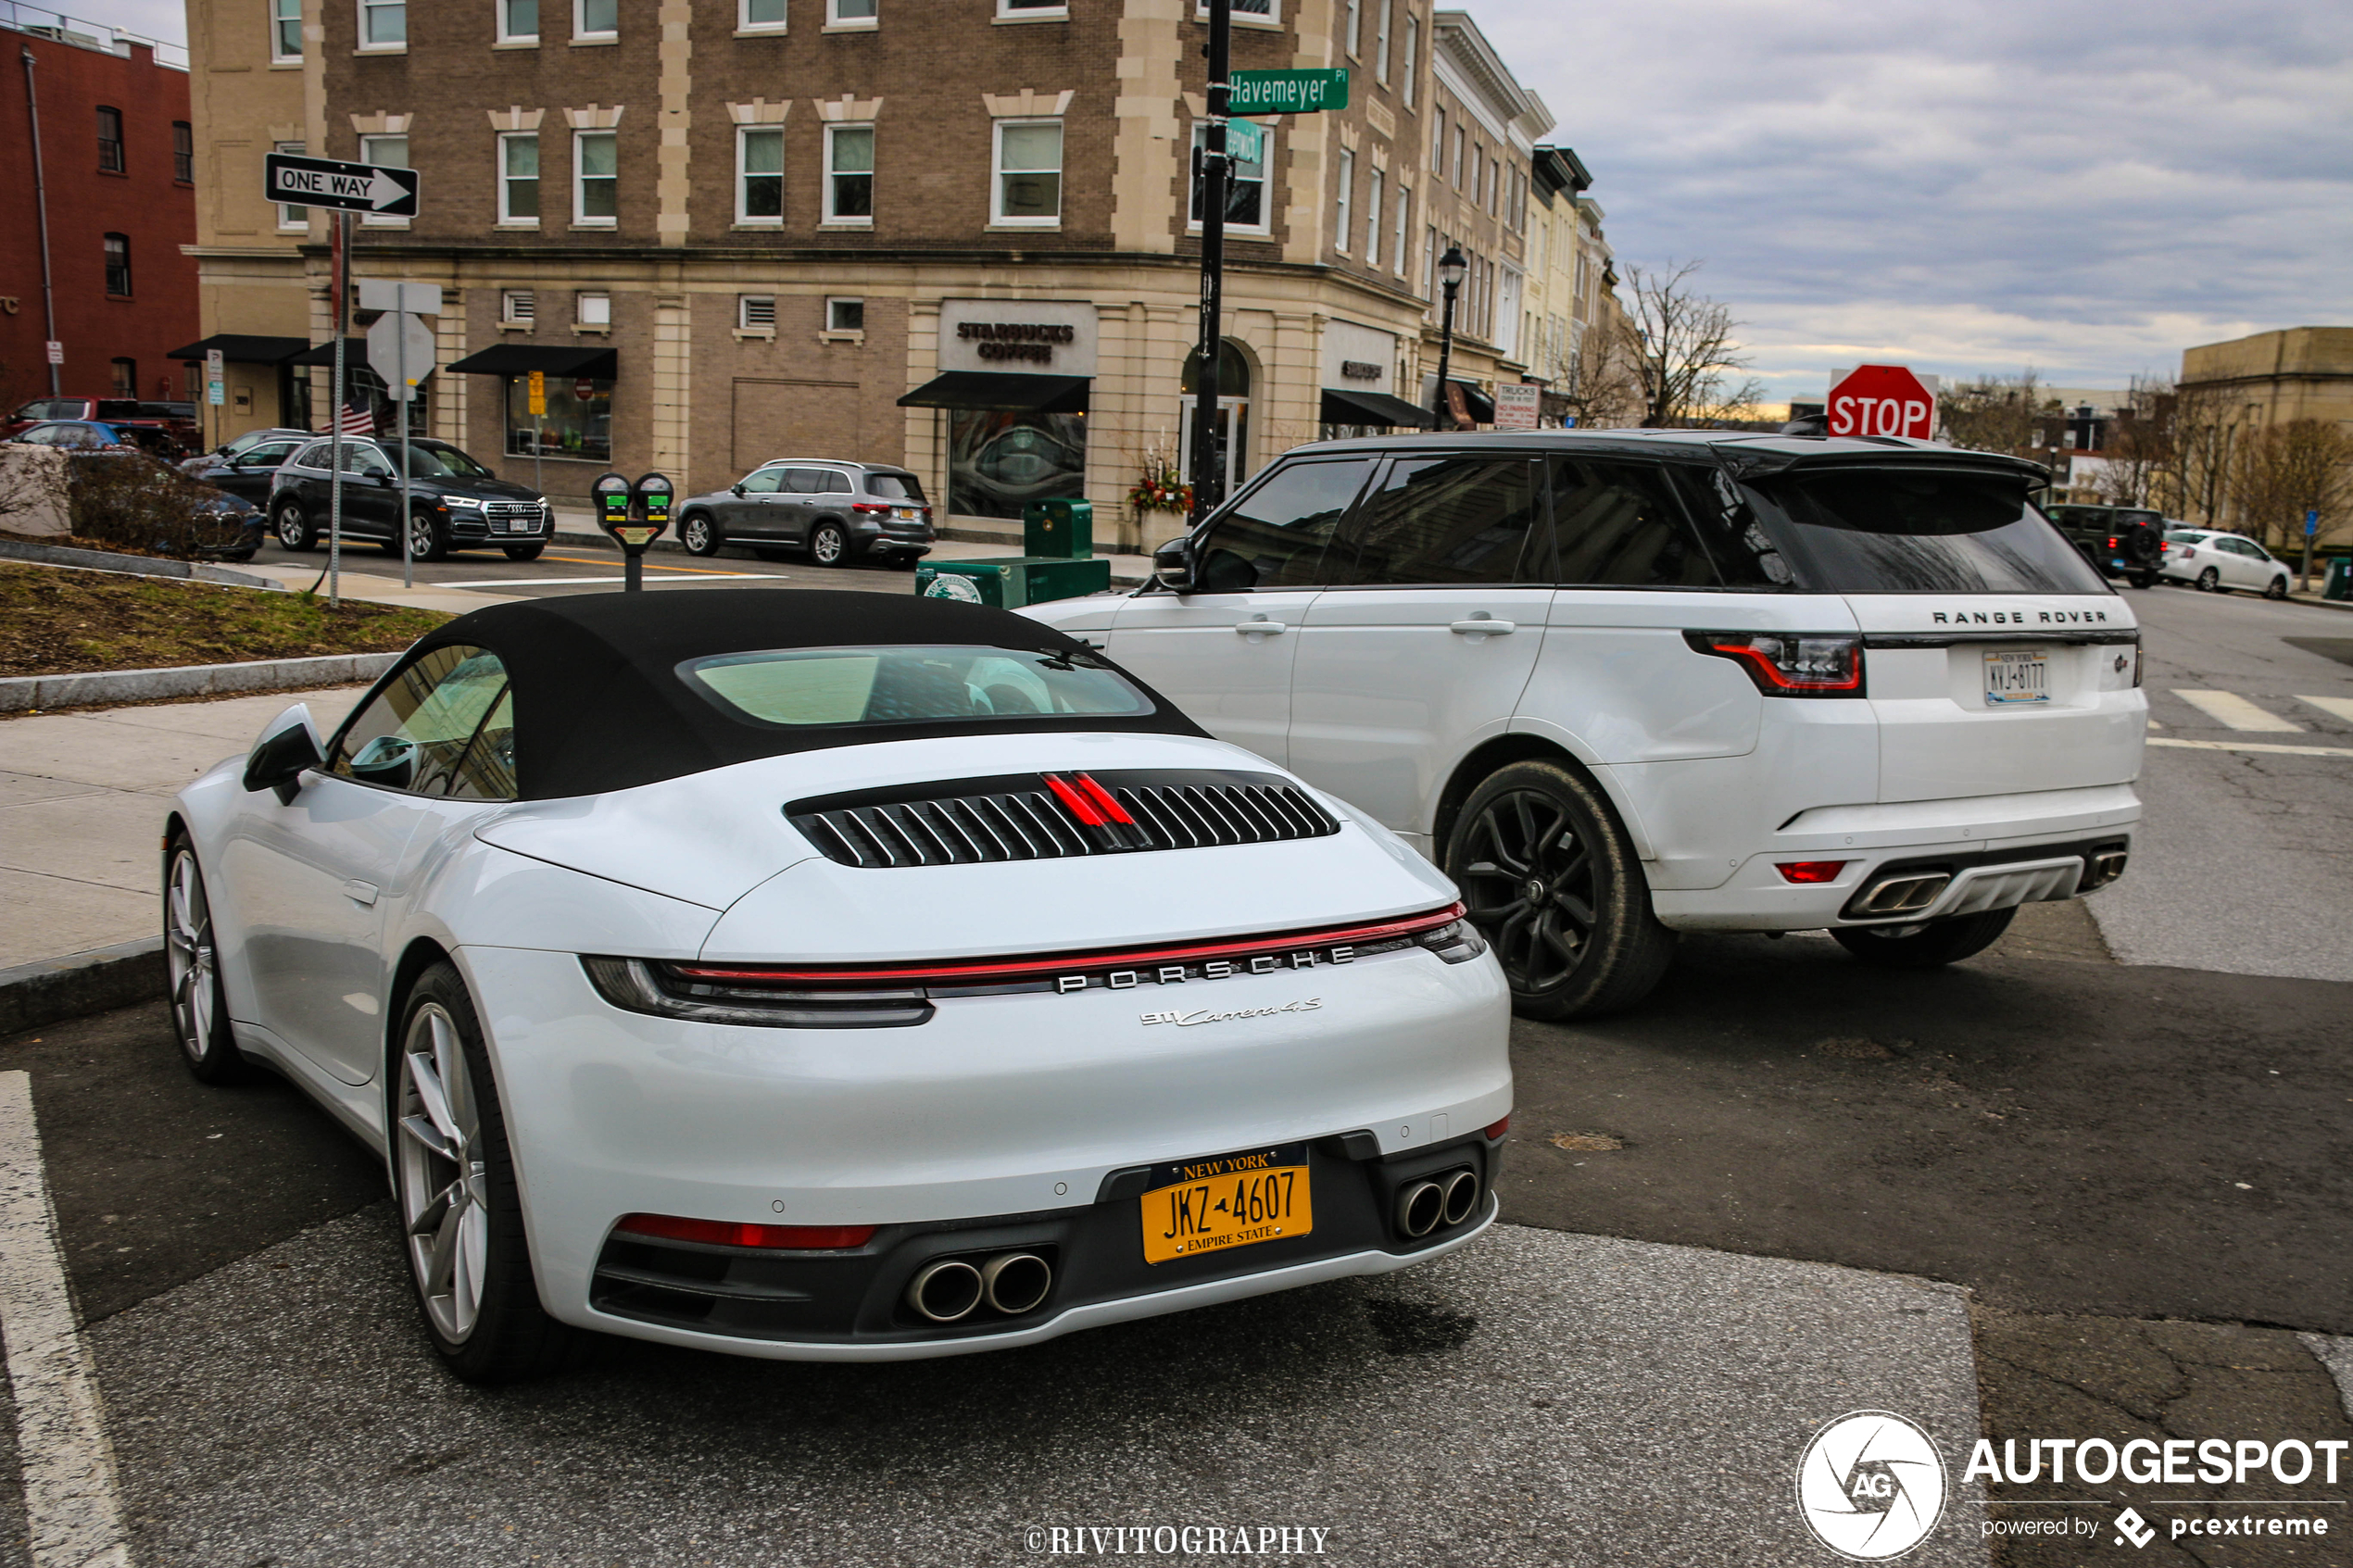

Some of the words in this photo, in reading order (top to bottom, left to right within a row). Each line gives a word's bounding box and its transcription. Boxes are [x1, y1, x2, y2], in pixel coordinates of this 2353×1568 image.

[1229, 75, 1327, 109] Havemeyer
[283, 170, 323, 192] ONE
[331, 175, 372, 197] WAY
[957, 321, 1075, 343] STARBUCKS
[977, 342, 1052, 365] COFFEE
[1502, 386, 1536, 395] TRUCKS
[1509, 405, 1535, 413] PARKING
[1831, 395, 1927, 438] STOP
[1932, 611, 2023, 624] RANGE
[2038, 610, 2107, 623] ROVER
[1990, 664, 2011, 691] KVJ
[2019, 662, 2045, 689] 8177
[1057, 946, 1354, 994] PORSCHE
[1139, 1010, 1183, 1026] 911
[1176, 1005, 1277, 1027] Carrera
[1184, 1160, 1223, 1181] NEW
[1227, 1153, 1269, 1172] YORK
[1163, 1185, 1212, 1239] JKZ
[1233, 1171, 1294, 1225] 4607
[1188, 1233, 1234, 1251] EMPIRE
[1237, 1224, 1272, 1243] STATE
